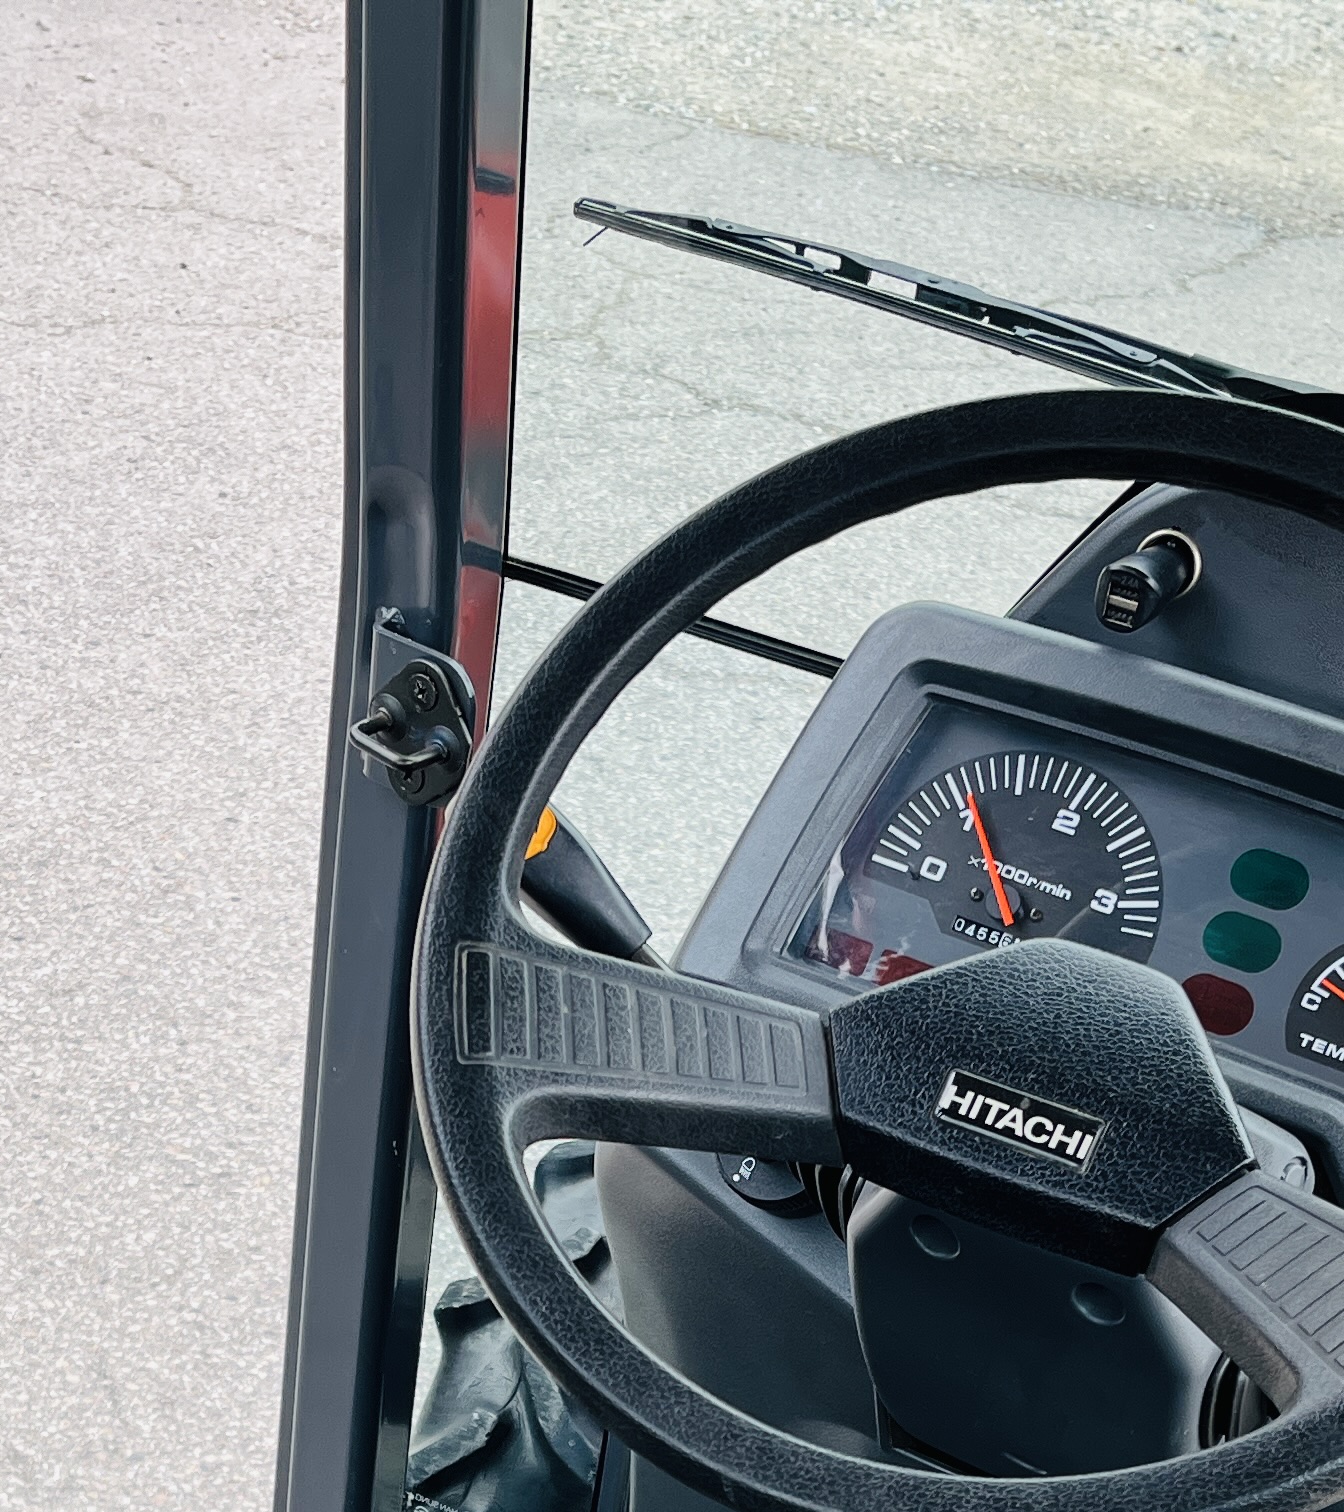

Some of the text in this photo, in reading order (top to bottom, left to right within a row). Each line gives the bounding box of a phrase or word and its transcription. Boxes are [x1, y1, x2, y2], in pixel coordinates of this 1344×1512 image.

[1051, 808, 1082, 836] 2
[919, 855, 948, 882] 0
[1090, 888, 1119, 915] 3
[1300, 991, 1323, 1012] C
[938, 1084, 1094, 1160] HITACHI
